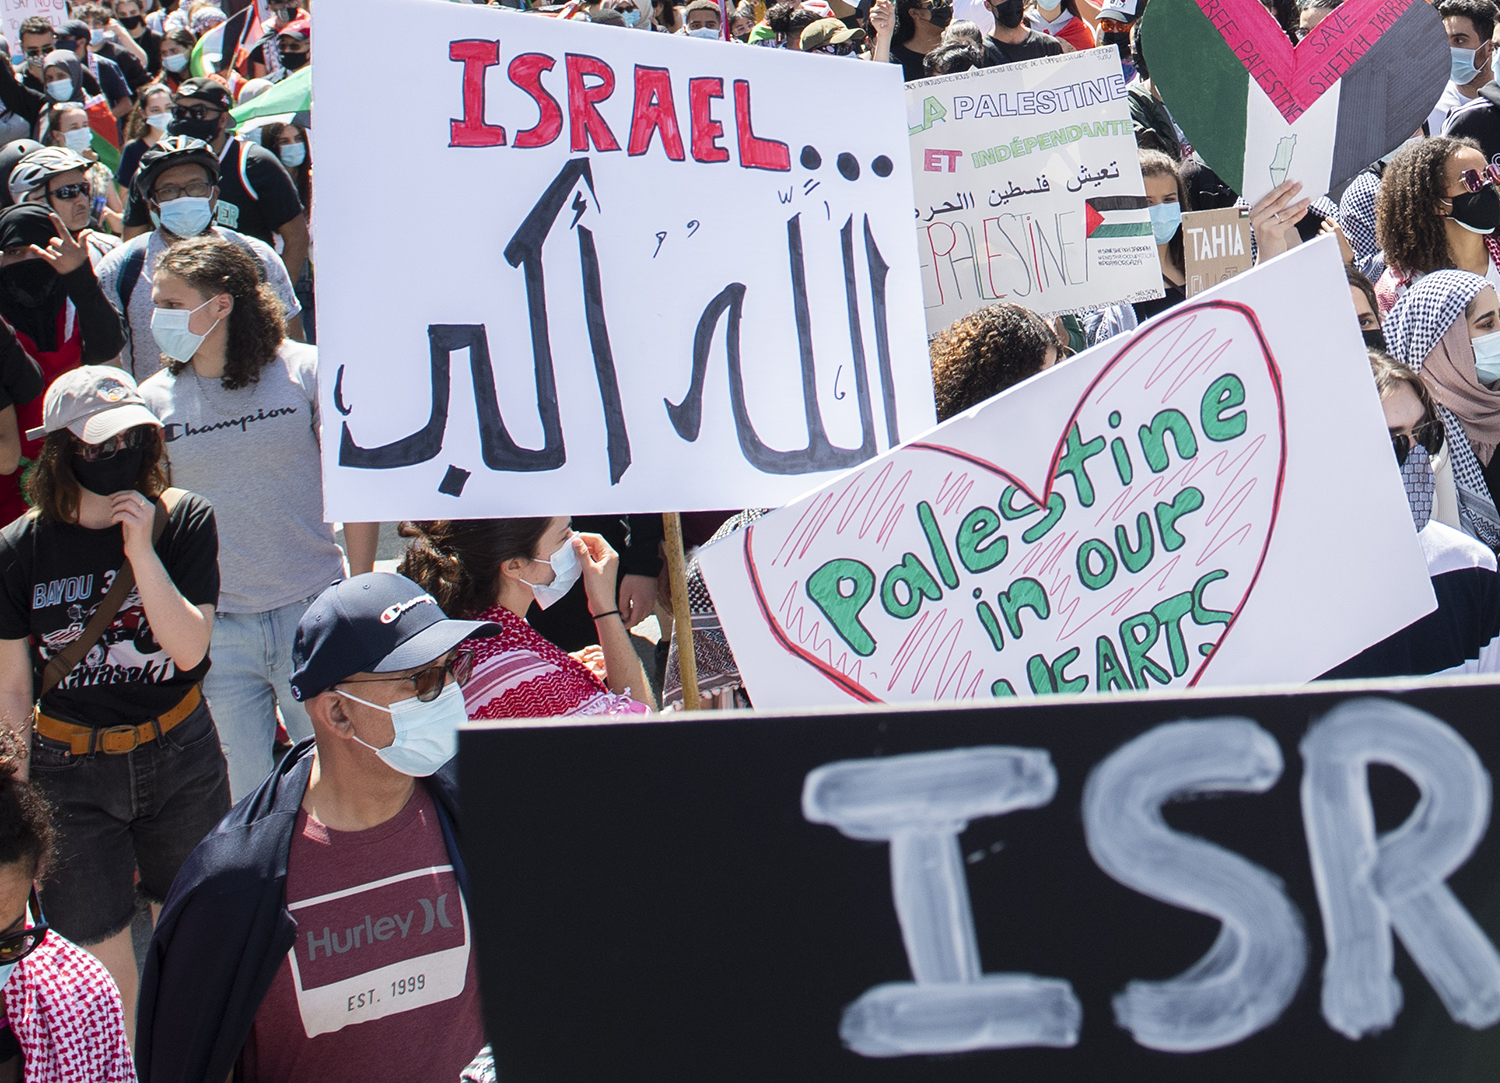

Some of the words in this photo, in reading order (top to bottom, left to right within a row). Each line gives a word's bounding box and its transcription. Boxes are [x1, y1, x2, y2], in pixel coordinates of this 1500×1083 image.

[1310, 8, 1357, 54] SAVE
[1234, 39, 1304, 120] PALESTINE
[1309, 36, 1372, 95] SHEIKH
[953, 74, 1129, 120] PALESTINE
[924, 148, 962, 173] ET
[971, 118, 1134, 170] INDÉPENDANTE
[988, 173, 1051, 207] فلسطين
[1065, 159, 1121, 193] تعيش
[927, 211, 1083, 306] PALESTINE
[1186, 222, 1245, 262] TAHIA
[162, 403, 297, 443] Champion
[806, 373, 1248, 658] Palestine
[971, 576, 1052, 652] in
[1075, 485, 1205, 591] our
[32, 574, 94, 610] BAYOU
[306, 901, 415, 963] Hurley
[347, 992, 381, 1013] EST.
[390, 973, 427, 999] 1999
